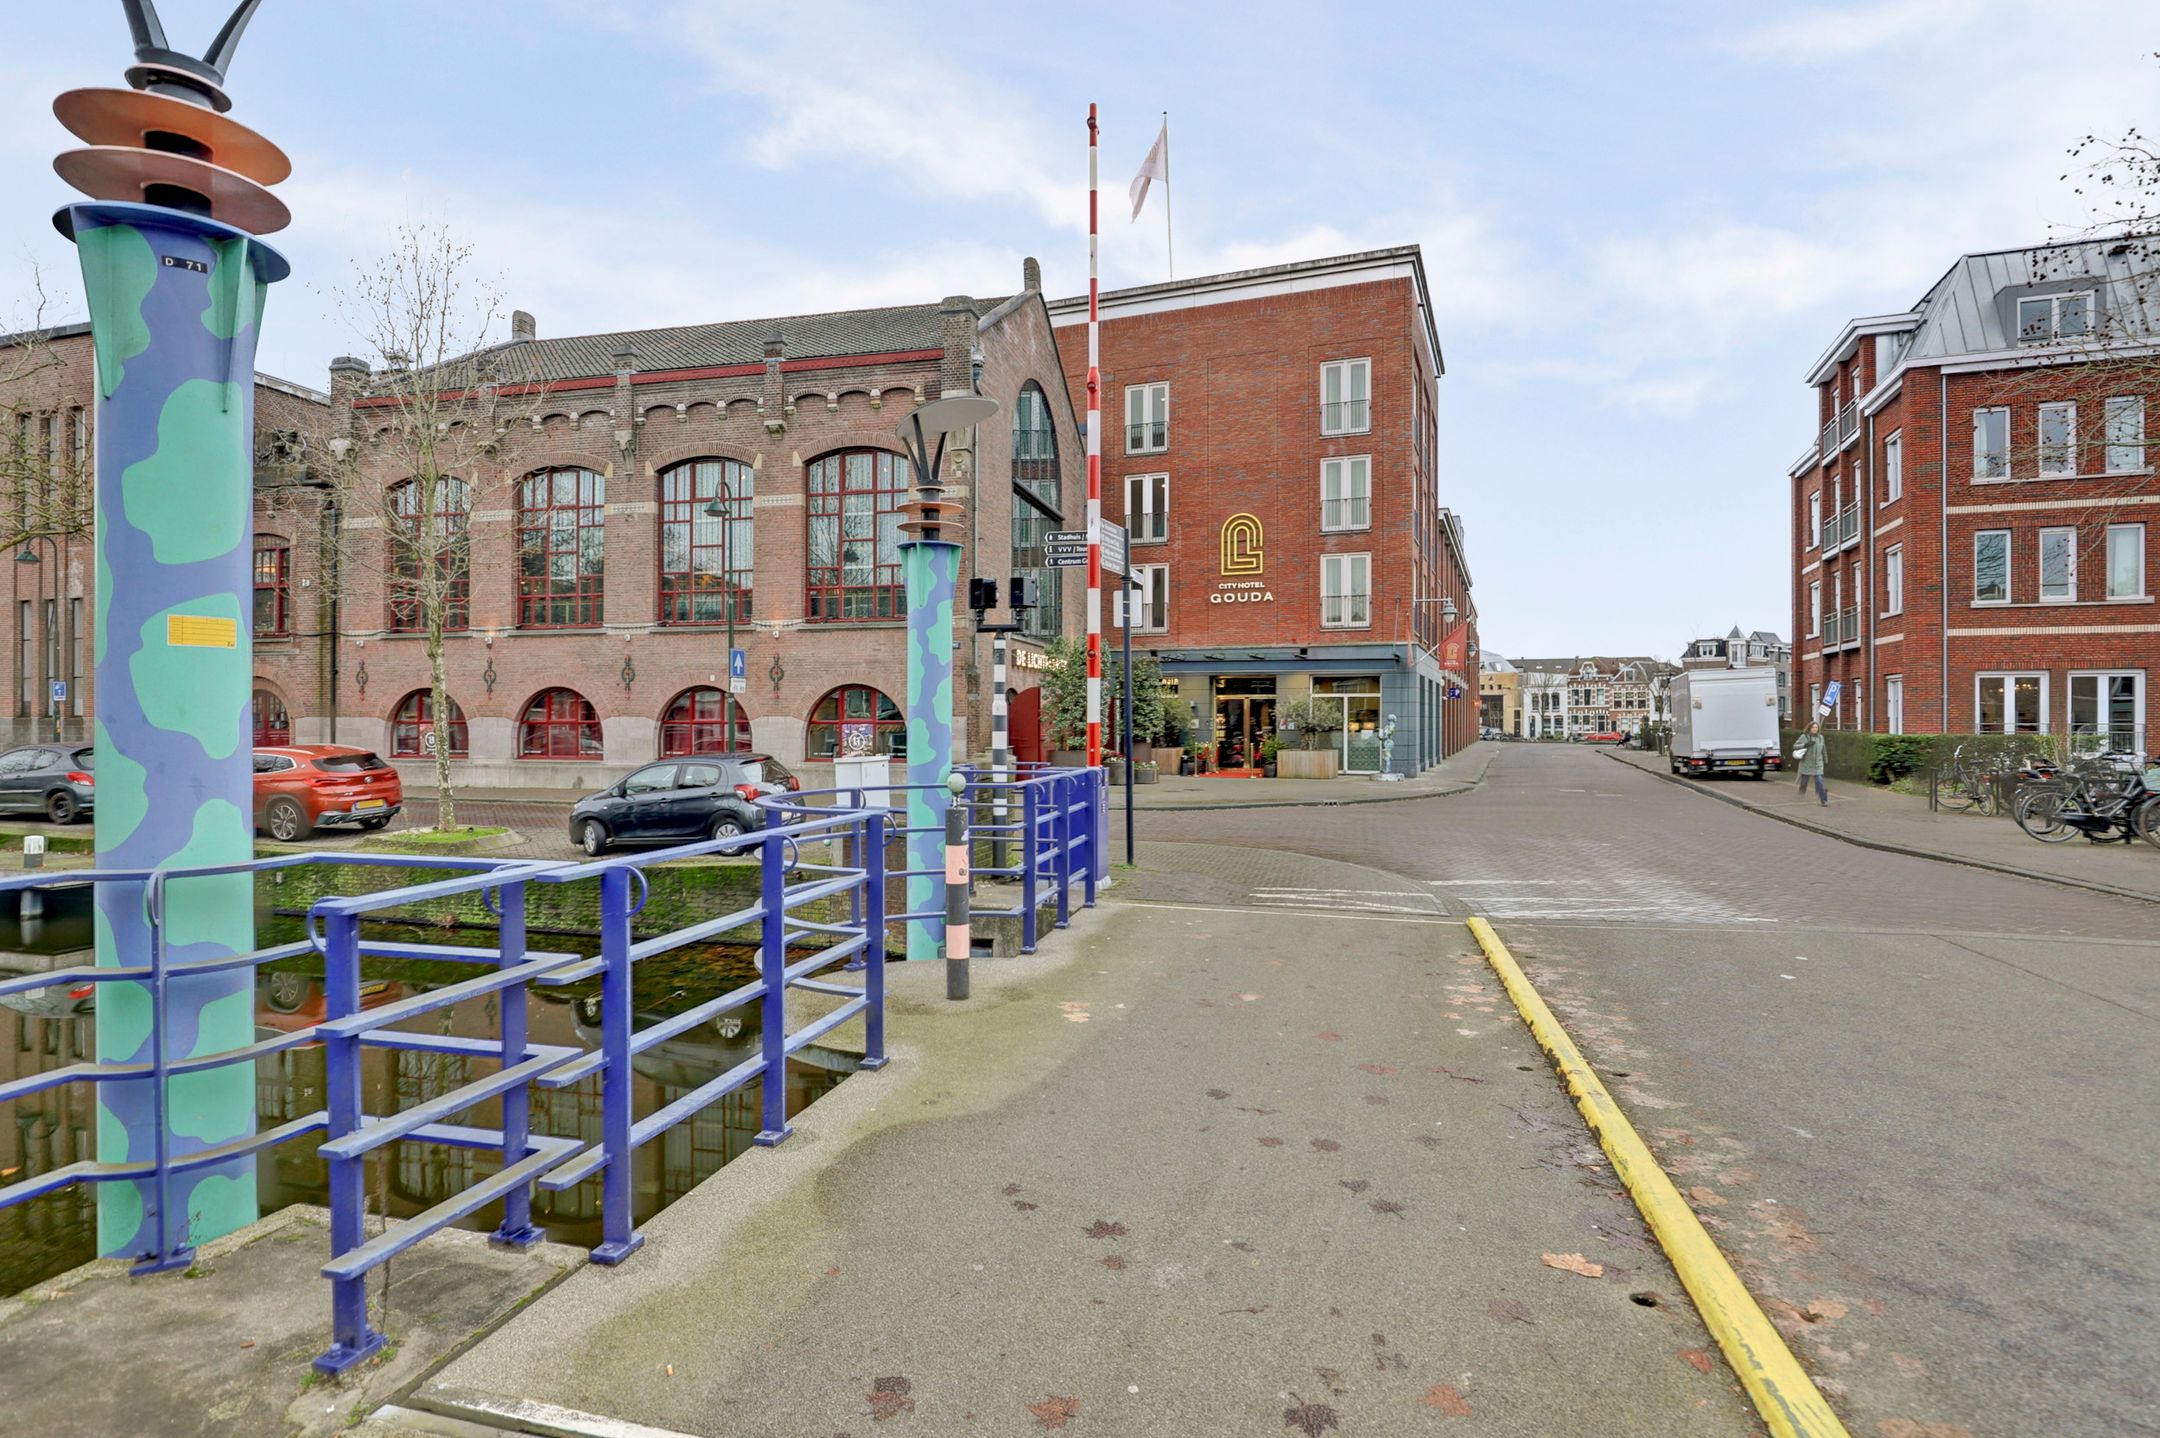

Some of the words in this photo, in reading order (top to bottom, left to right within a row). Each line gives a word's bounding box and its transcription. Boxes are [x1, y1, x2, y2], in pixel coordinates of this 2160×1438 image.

[165, 257, 174, 266] D
[186, 260, 202, 271] 71
[1210, 592, 1274, 603] GOUDA
[1016, 649, 1027, 666] DE
